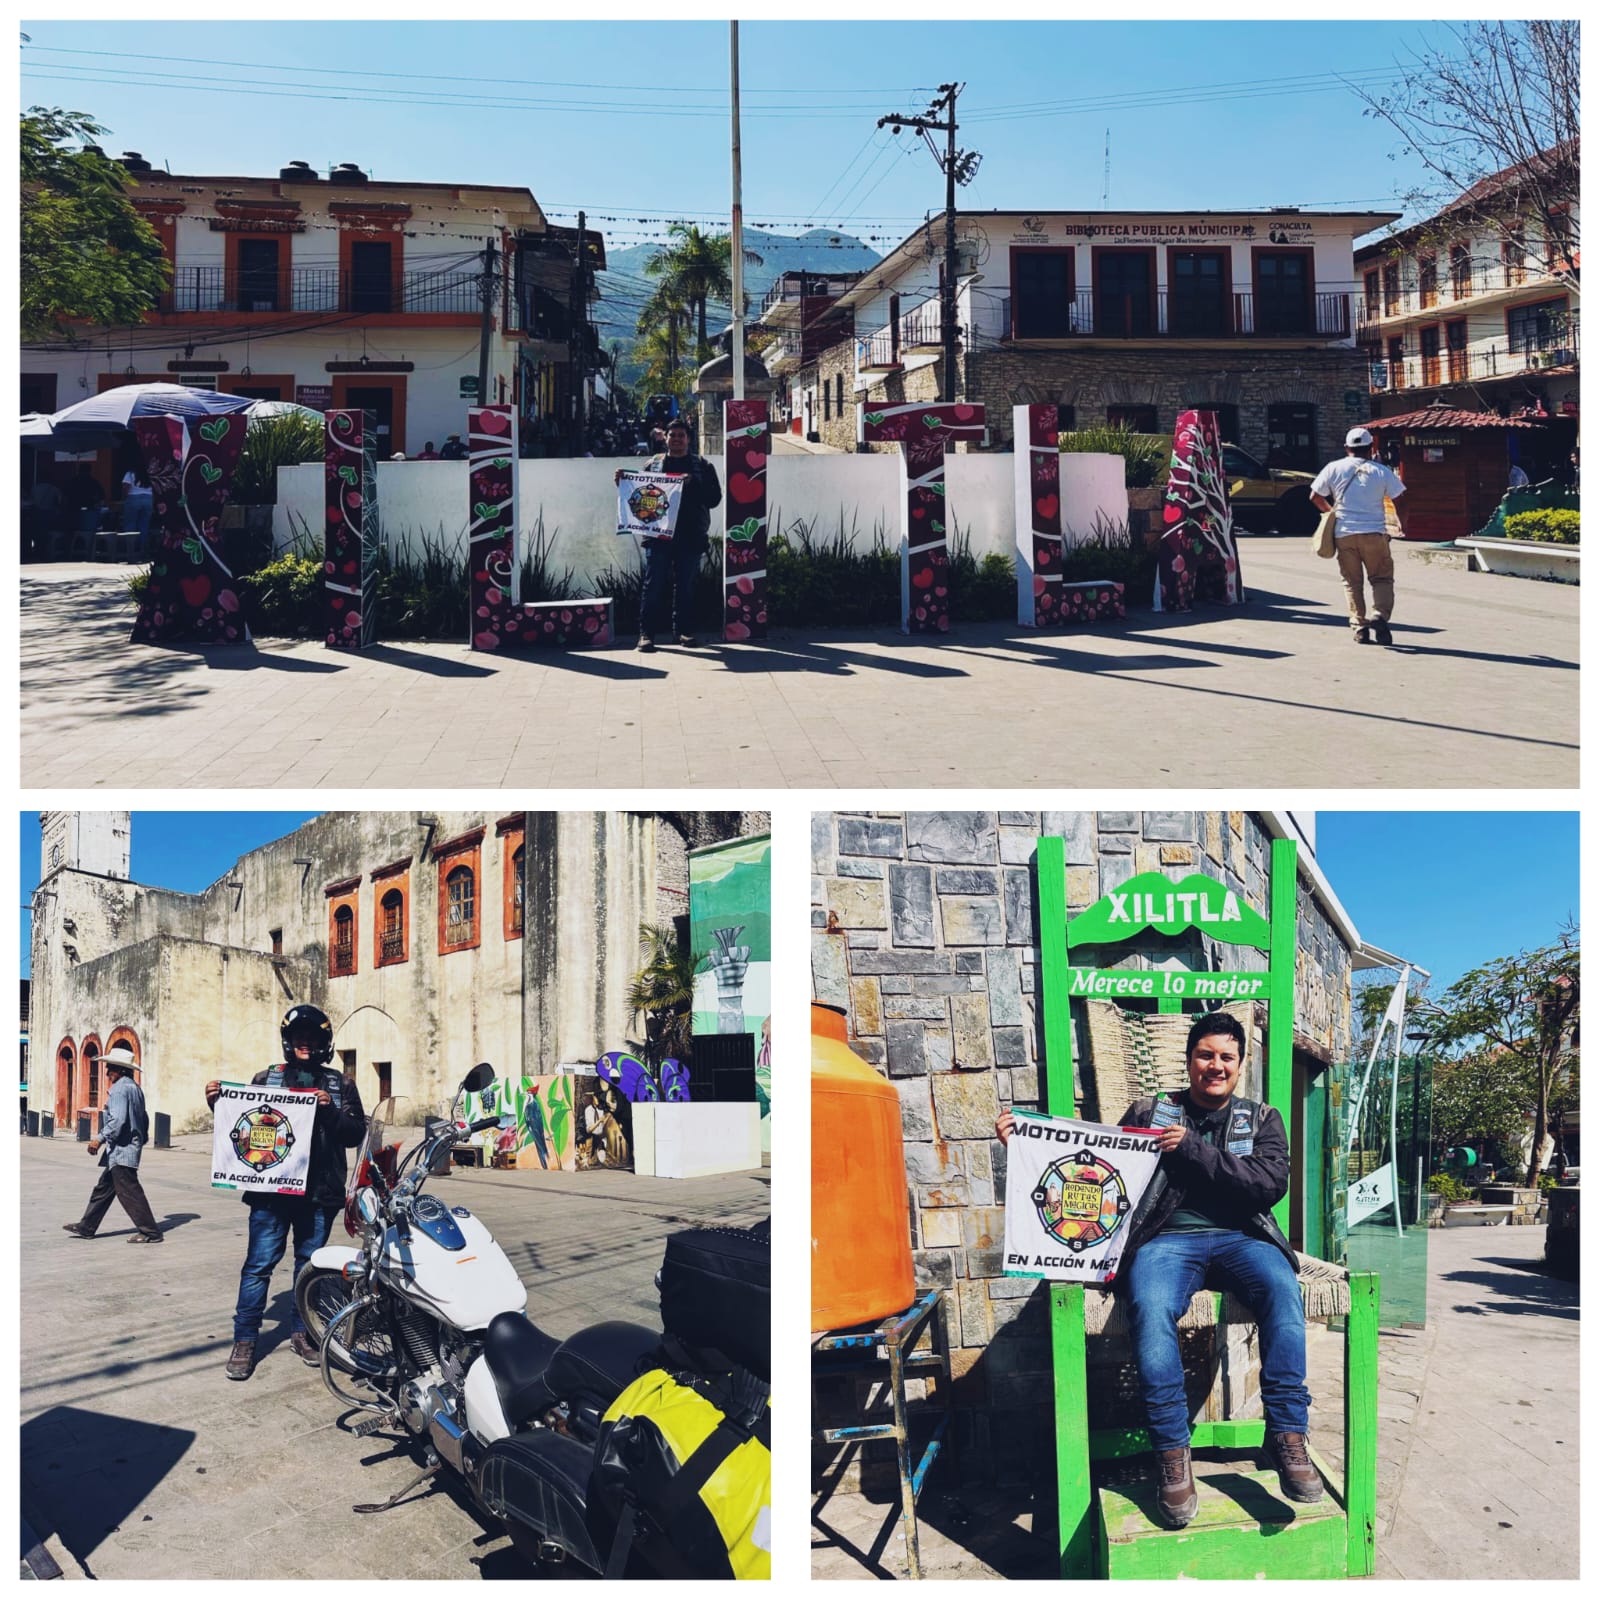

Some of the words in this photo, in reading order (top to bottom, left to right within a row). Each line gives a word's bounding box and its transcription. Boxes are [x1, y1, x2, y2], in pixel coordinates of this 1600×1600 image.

[1066, 225, 1130, 236] BIBLOTECA
[1132, 225, 1186, 236] PUBLICA
[1188, 224, 1256, 236] MUNICIPA
[621, 473, 683, 484] MOTOTURISMO
[1108, 892, 1242, 923] XILITLA
[1069, 970, 1153, 996] Merece
[1163, 972, 1185, 995] lo
[1195, 975, 1263, 998] mejor
[217, 1088, 316, 1105] MOTOTURISMO
[1011, 1122, 1161, 1153] MOTOTURISMO
[1080, 1154, 1092, 1163] N
[213, 1172, 226, 1180] EN
[229, 1173, 265, 1184] ACCIÓN
[268, 1175, 304, 1186] MÉXICO
[1034, 1192, 1044, 1200] O
[1119, 1202, 1128, 1210] E
[1073, 1241, 1082, 1249] S
[1007, 1254, 1029, 1265] EN
[1034, 1253, 1085, 1269] ACCIÓN
